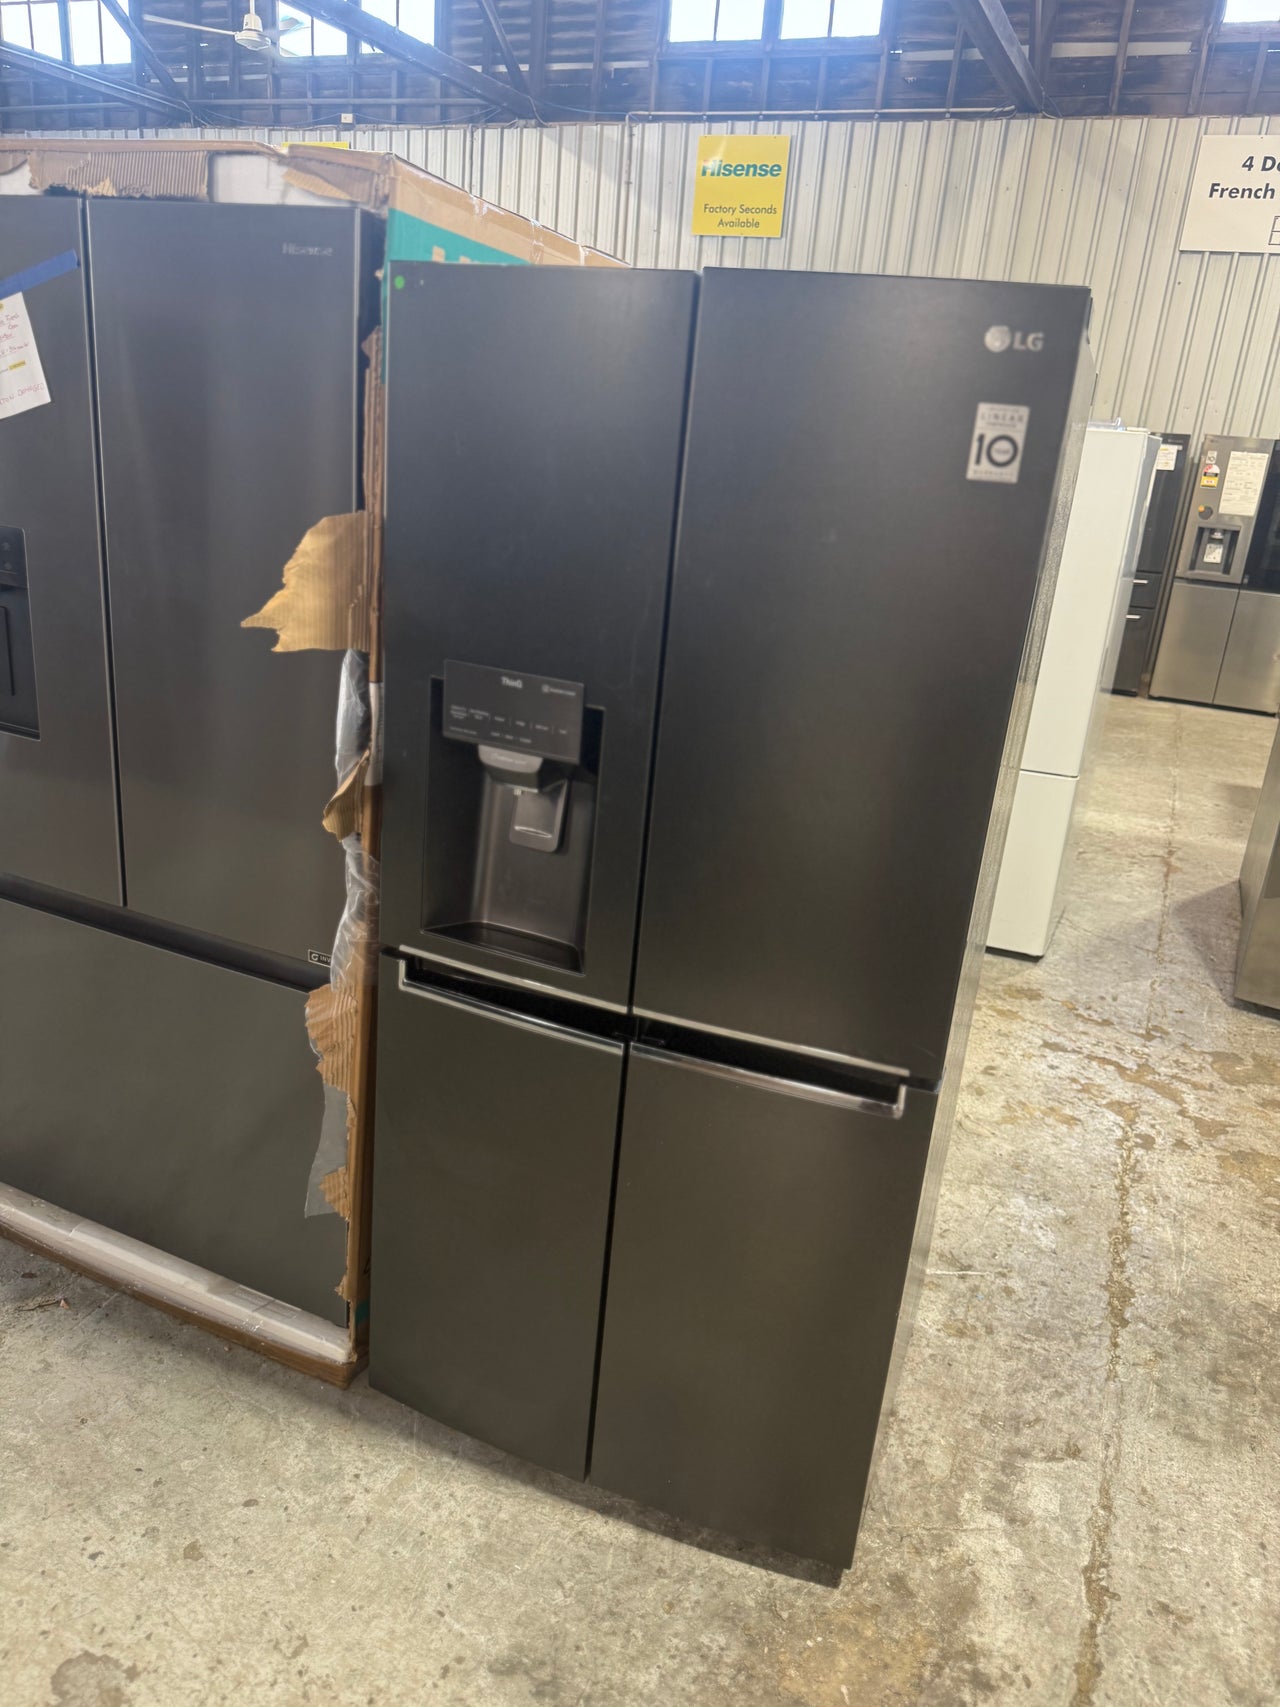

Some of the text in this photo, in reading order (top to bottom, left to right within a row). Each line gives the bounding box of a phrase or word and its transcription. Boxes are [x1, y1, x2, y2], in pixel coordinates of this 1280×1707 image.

[701, 159, 782, 177] Hisense
[1241, 156, 1254, 171] 4
[1208, 182, 1276, 199] French
[703, 203, 777, 216] Factory Seconds
[717, 218, 760, 229] Available
[1012, 331, 1045, 351] LG
[974, 432, 1019, 468] 10
